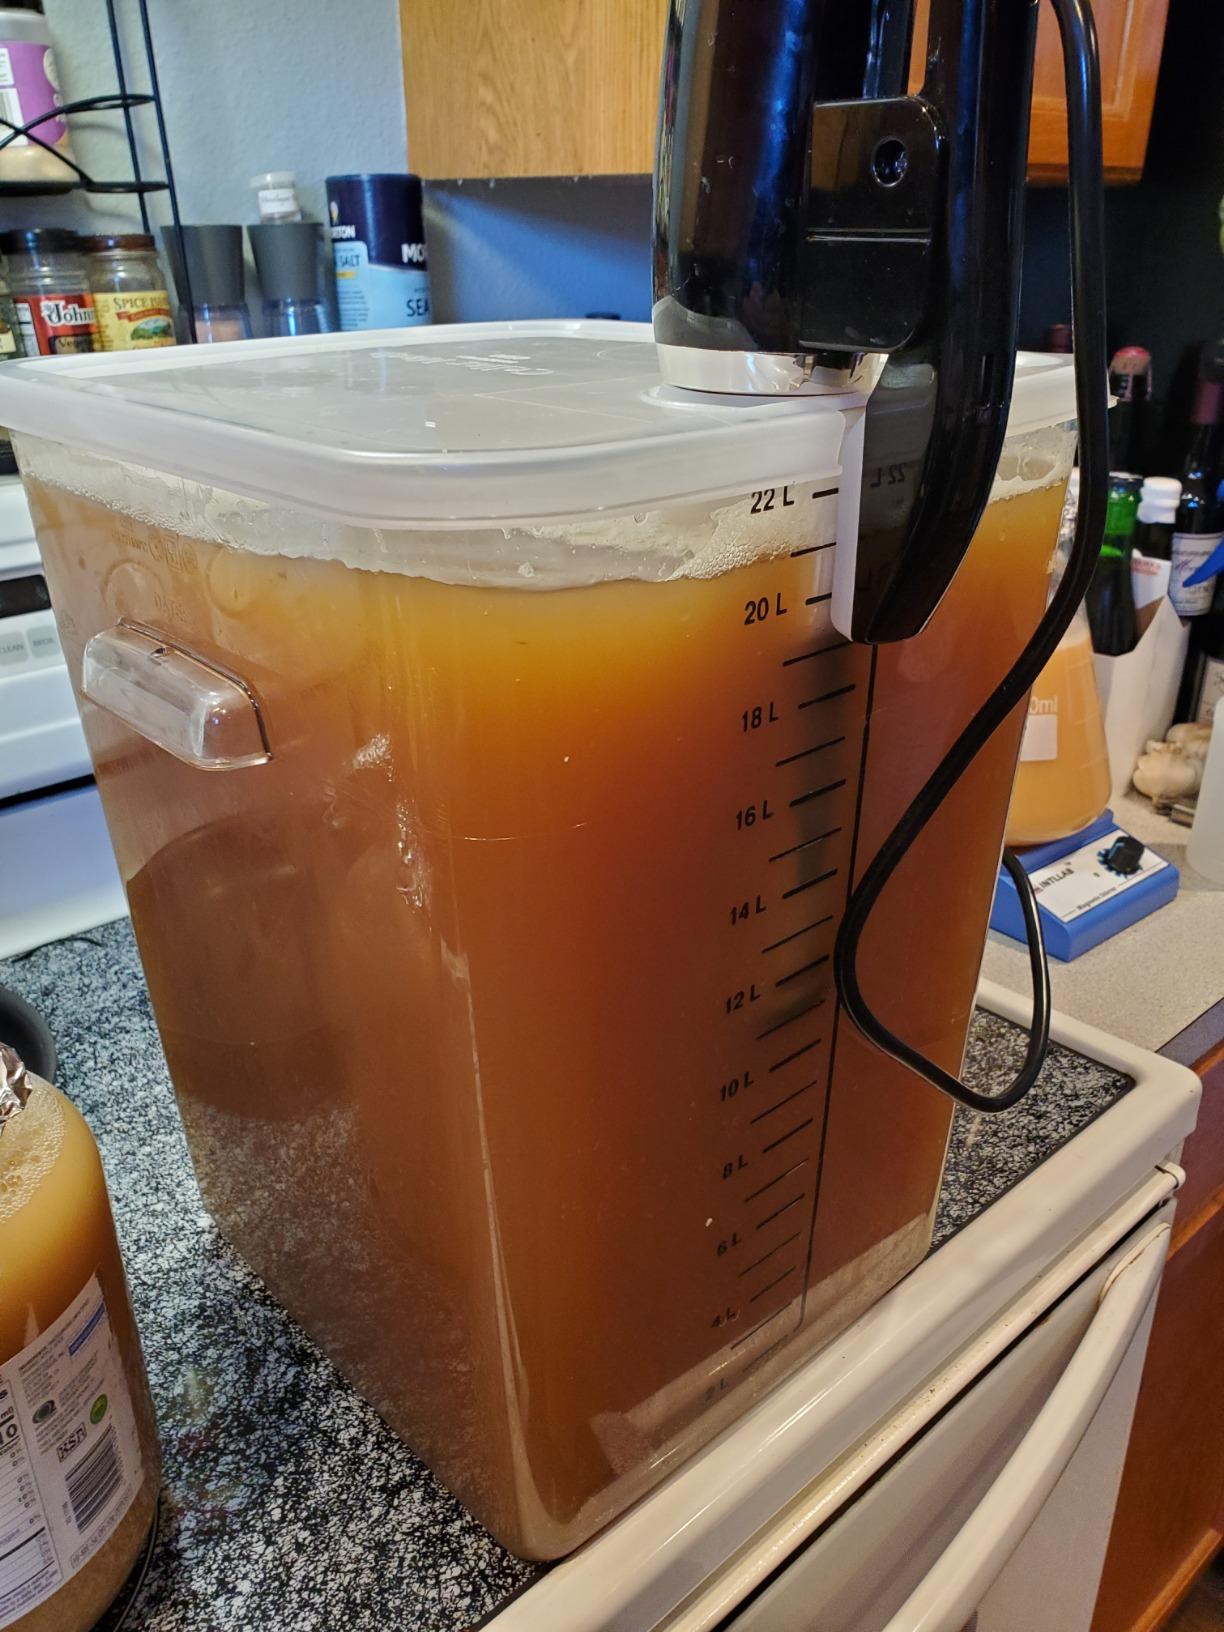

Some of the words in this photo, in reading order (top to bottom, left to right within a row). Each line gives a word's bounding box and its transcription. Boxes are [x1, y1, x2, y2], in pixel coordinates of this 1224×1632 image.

[401, 243, 425, 264] MO
[750, 488, 776, 515] 22
[782, 485, 795, 507] L
[743, 597, 769, 626] 20
[776, 592, 788, 617] L
[741, 706, 763, 733] 18
[769, 701, 780, 723] L
[735, 805, 757, 831] 16
[762, 799, 774, 820] L
[730, 902, 750, 926] 14
[755, 895, 767, 914] L
[726, 990, 745, 1014] 12
[749, 984, 761, 1002] L
[721, 1079, 739, 1102] 10
[743, 1071, 754, 1089] L
[722, 1162, 733, 1180] 8
[737, 1154, 748, 1171] L
[730, 1232, 742, 1247] L
